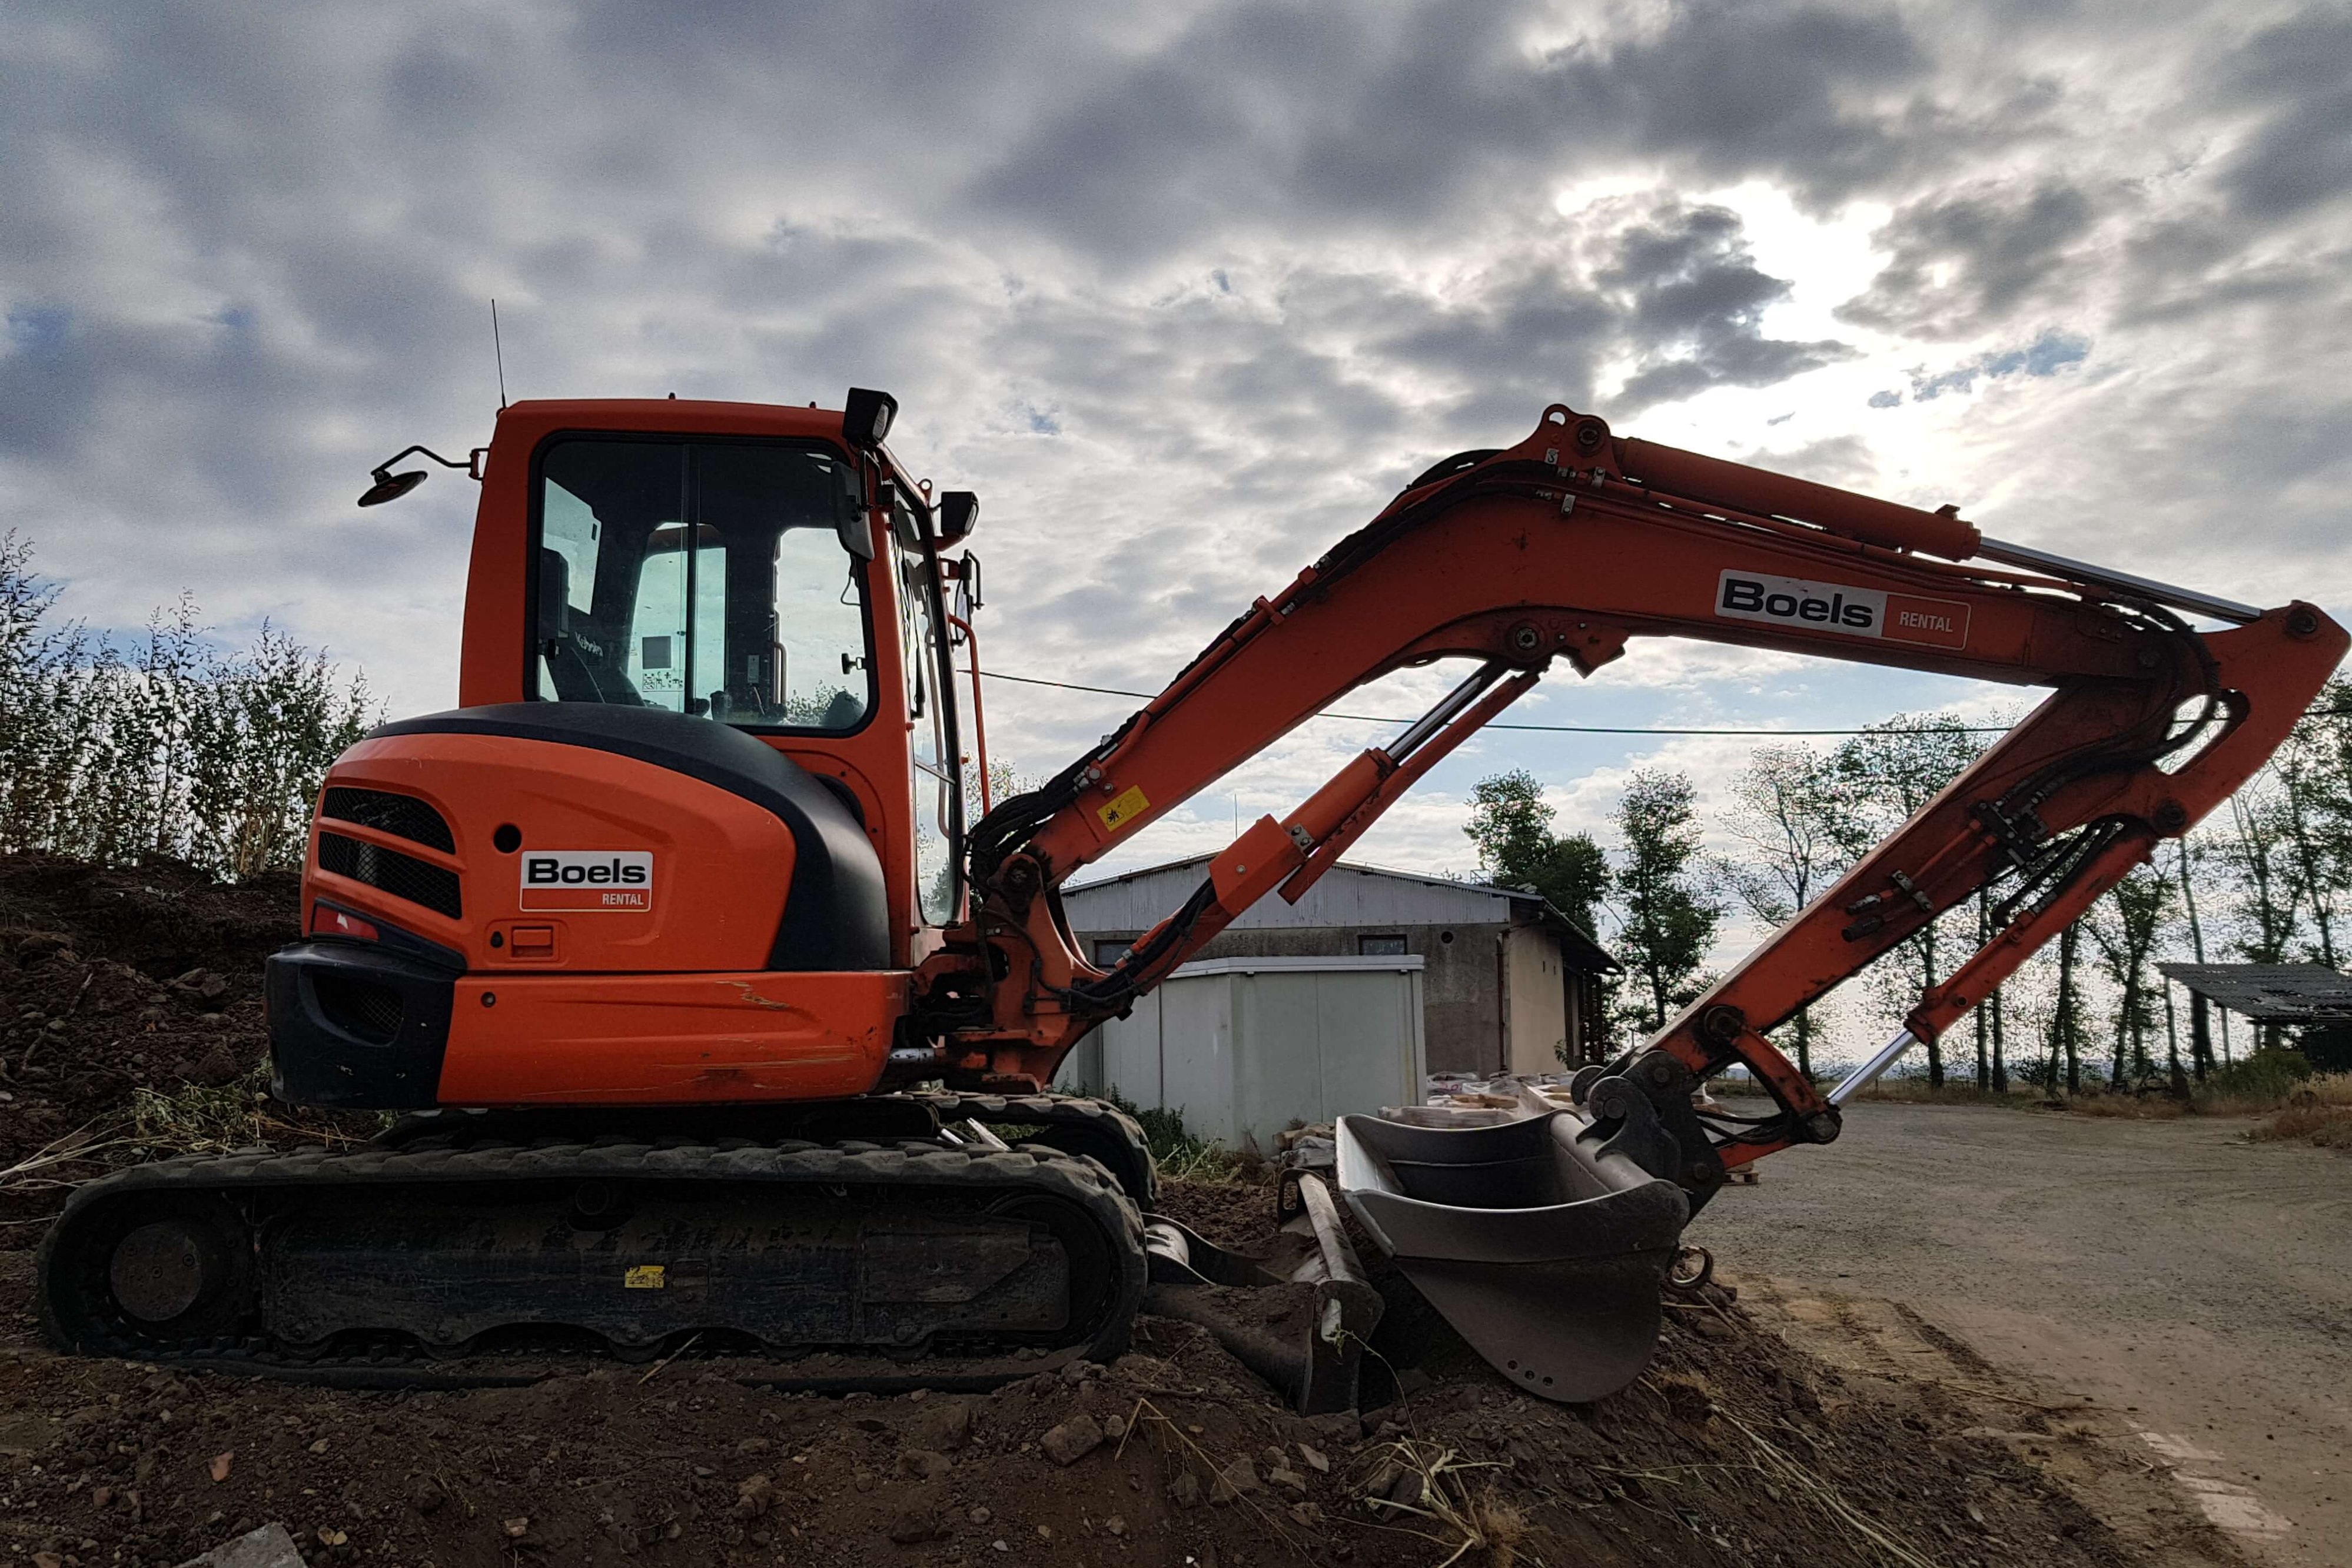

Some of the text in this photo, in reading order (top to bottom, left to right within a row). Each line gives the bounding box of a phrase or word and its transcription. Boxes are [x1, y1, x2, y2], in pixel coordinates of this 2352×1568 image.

[1722, 579, 1954, 632] Boels RENTAL
[528, 858, 646, 883] Boels
[602, 893, 644, 905] RENTAL
